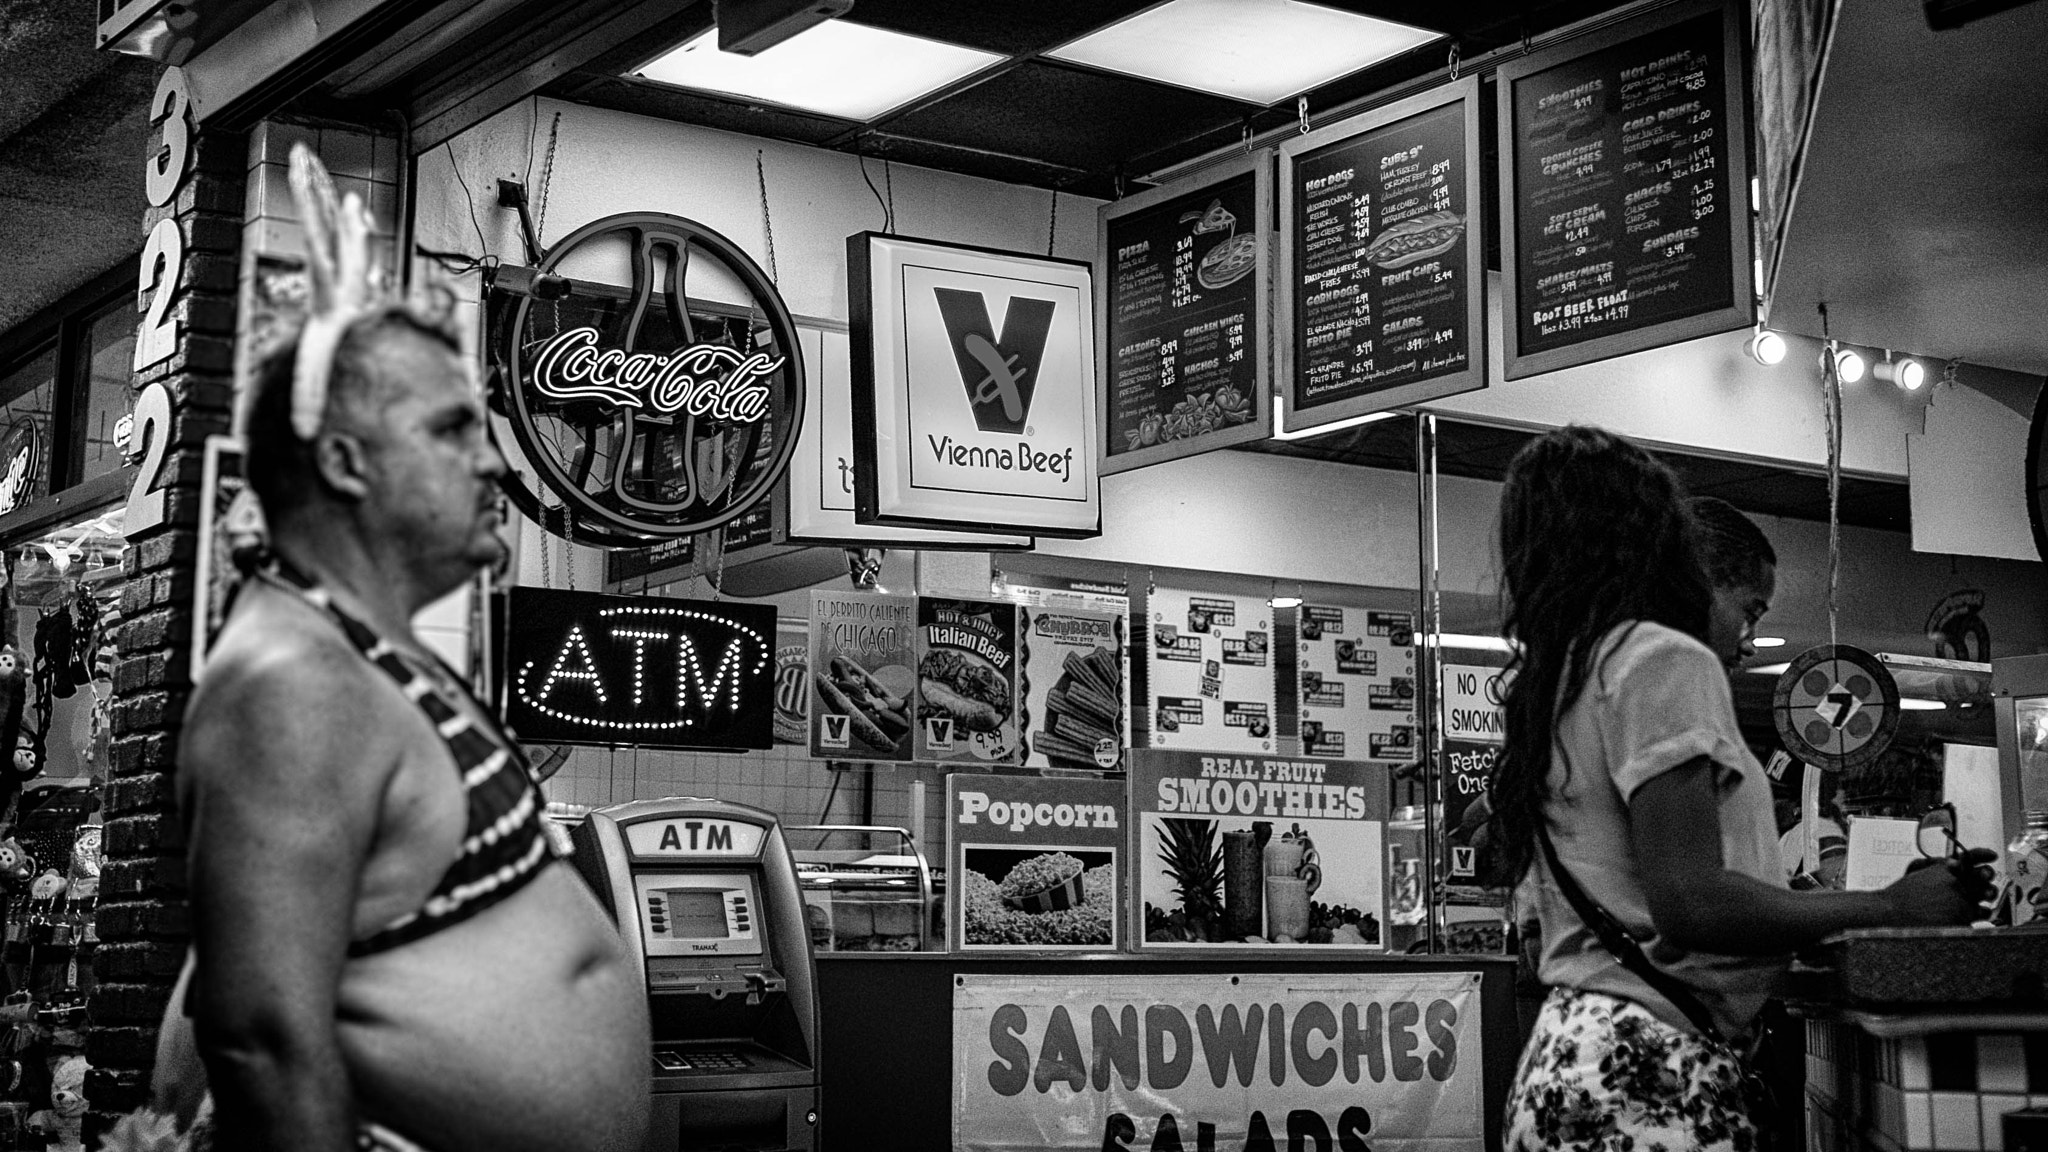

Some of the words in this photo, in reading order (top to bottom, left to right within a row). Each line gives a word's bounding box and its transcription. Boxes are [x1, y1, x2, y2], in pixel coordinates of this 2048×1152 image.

[1680, 70, 1704, 83] cocoa
[1539, 80, 1604, 110] SMOOTHIES
[1623, 115, 1656, 133] COLD
[1658, 100, 1702, 121] DRINKS
[1380, 151, 1409, 170] SUBS
[1409, 145, 1424, 159] 9"
[1541, 149, 1571, 167] FROZEN
[1572, 140, 1603, 157] COFFEE
[1542, 150, 1604, 175] CRUNCHES
[1306, 178, 1327, 192] HOT
[1327, 168, 1355, 186] DOGS
[1623, 181, 1672, 206] SNACKS
[1543, 222, 1563, 236] ICE
[1565, 209, 1606, 229] CREAM
[1549, 211, 1573, 225] SOFT
[1573, 203, 1600, 217] SERVE
[1118, 240, 1150, 262] PIZZA
[1642, 226, 1700, 253] SUNDAES
[1381, 269, 1412, 286] FRUIT
[1411, 261, 1441, 278] CUPS
[1306, 289, 1333, 307] CORN
[1332, 284, 1361, 301] DOGS
[1533, 306, 1562, 326] ROOT
[1563, 298, 1596, 317] BEER
[1597, 289, 1628, 310] FLOAT
[1183, 320, 1219, 338] CHICKEN
[1218, 314, 1245, 331] WINGS
[1306, 331, 1335, 348] FRITO
[1336, 325, 1354, 341] PIE
[1382, 316, 1424, 336] SALADS
[1118, 337, 1162, 358] CALZONES
[1184, 357, 1220, 377] NACHOS
[1310, 374, 1331, 387] FRITO
[1331, 370, 1344, 381] PIE
[928, 434, 1014, 472] Vienna
[1018, 442, 1073, 484] Beef
[817, 599, 828, 616] EL
[869, 603, 911, 623] CALIENTE
[937, 610, 961, 623] HOT
[964, 614, 976, 626] &
[973, 616, 1004, 642] JUICY
[834, 622, 897, 657] CHICAGO
[928, 624, 977, 652] Italian
[977, 634, 1012, 669] Beef
[538, 624, 742, 711] ATM
[1457, 672, 1477, 696] NO
[1451, 708, 1505, 734] SMOKIN
[1827, 692, 1853, 728] 7
[975, 728, 1003, 750] 9.99
[1200, 757, 1259, 780] REAL
[1262, 760, 1327, 783] FRUIT
[1156, 776, 1366, 820] SMOOTHIES
[958, 791, 1118, 833] Popcorn
[659, 821, 734, 851] ATM
[986, 998, 1458, 1096] SANDWICHES
